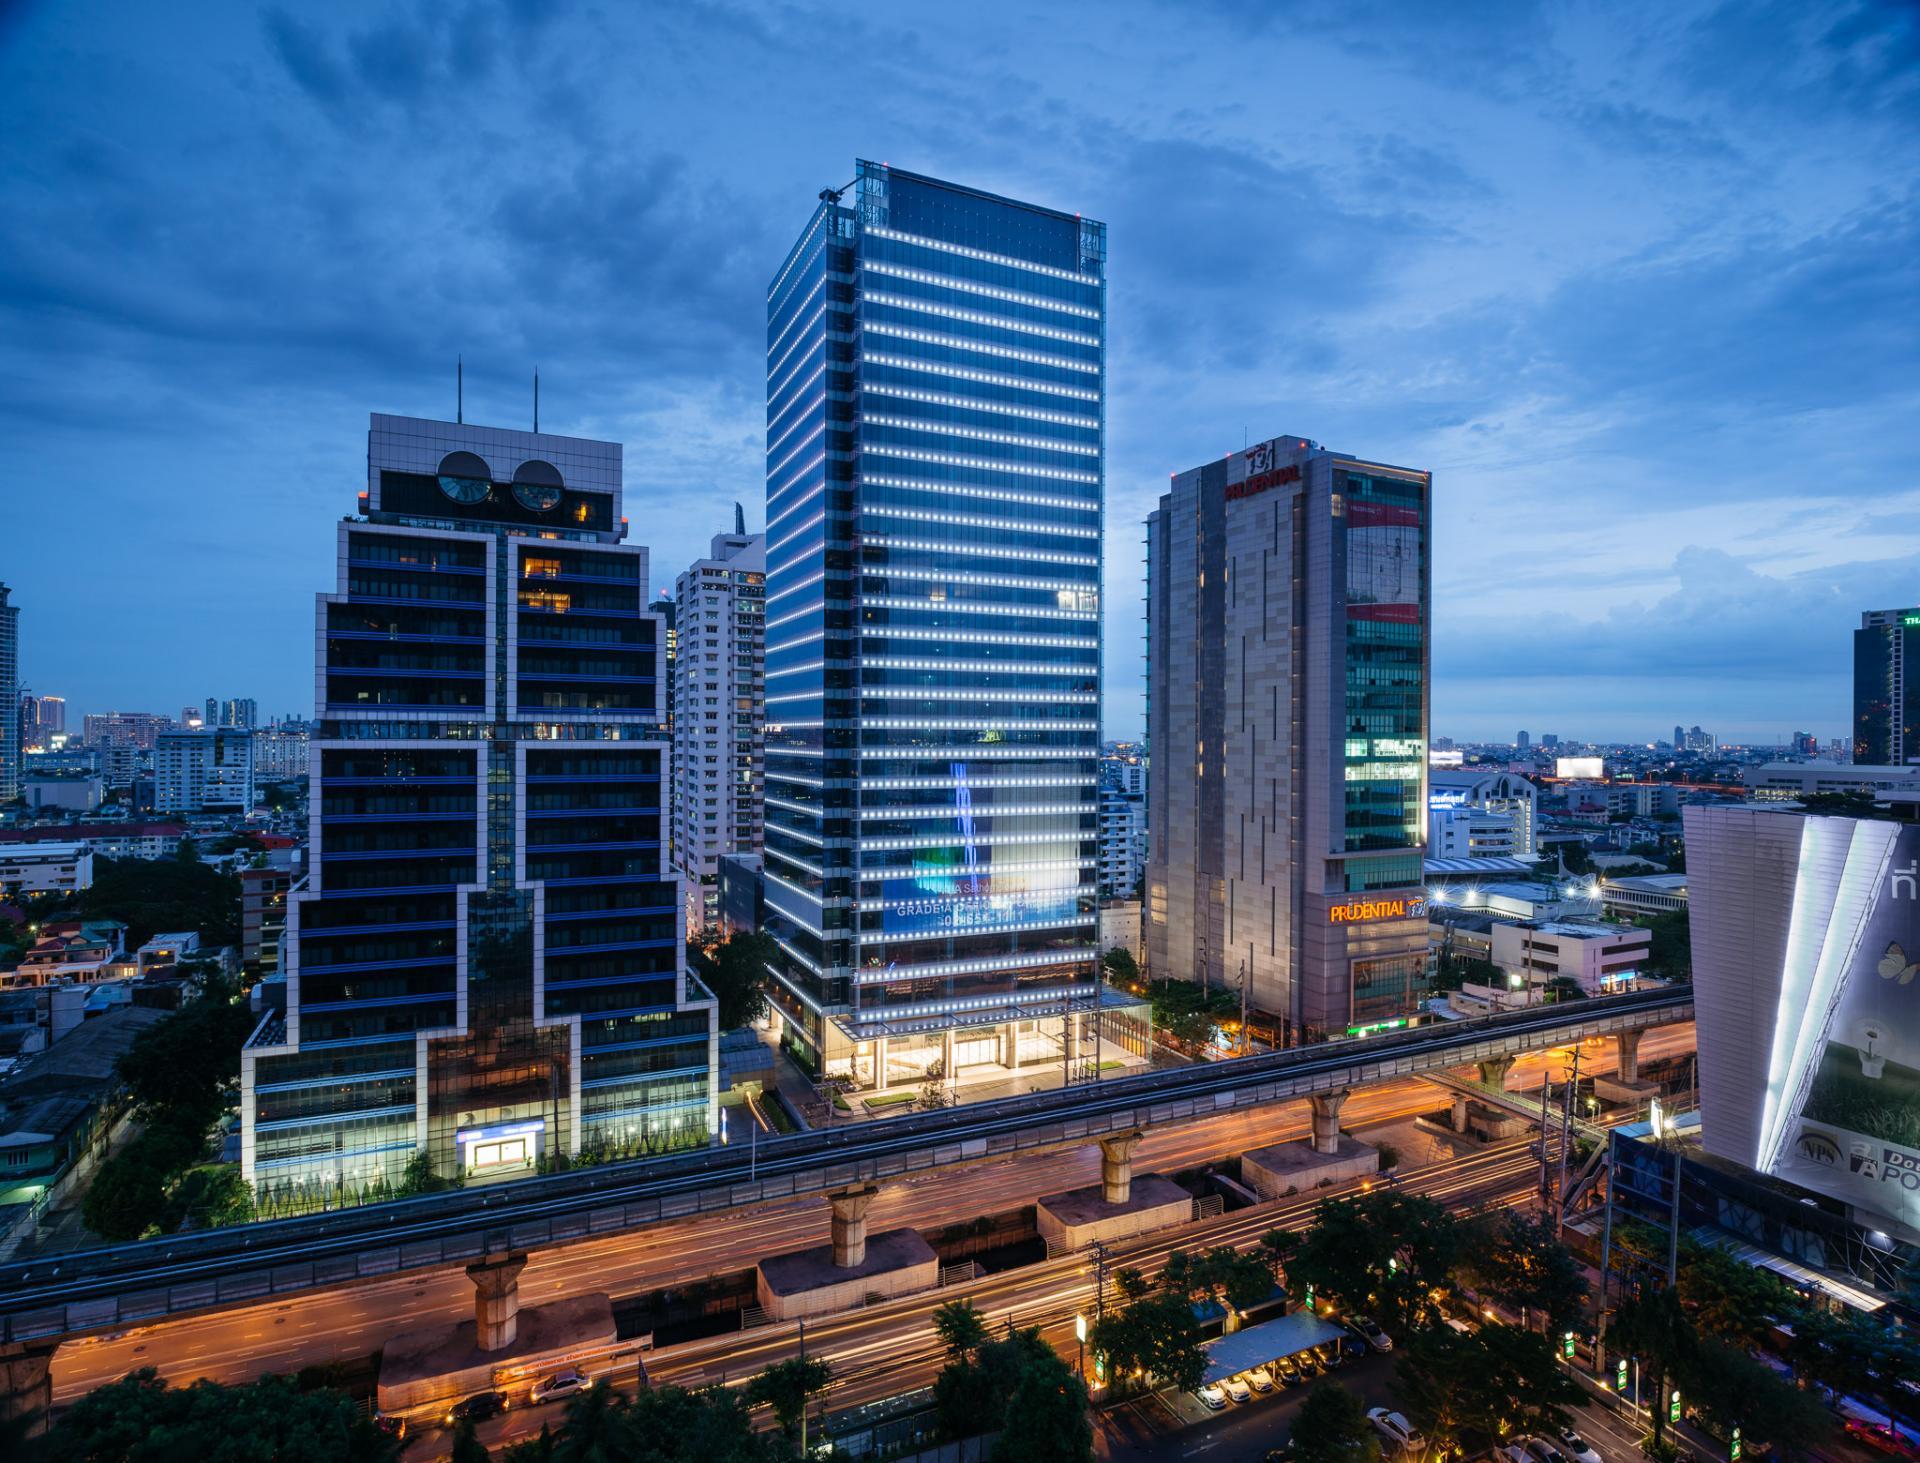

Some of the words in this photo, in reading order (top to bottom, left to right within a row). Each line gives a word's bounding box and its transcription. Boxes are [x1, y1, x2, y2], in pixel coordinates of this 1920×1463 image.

[1225, 464, 1301, 502] PRUDENTIAL
[897, 904, 940, 917] GRADE
[1330, 900, 1406, 922] PRUDENTIAL
[1802, 1140, 1835, 1164] NPS
